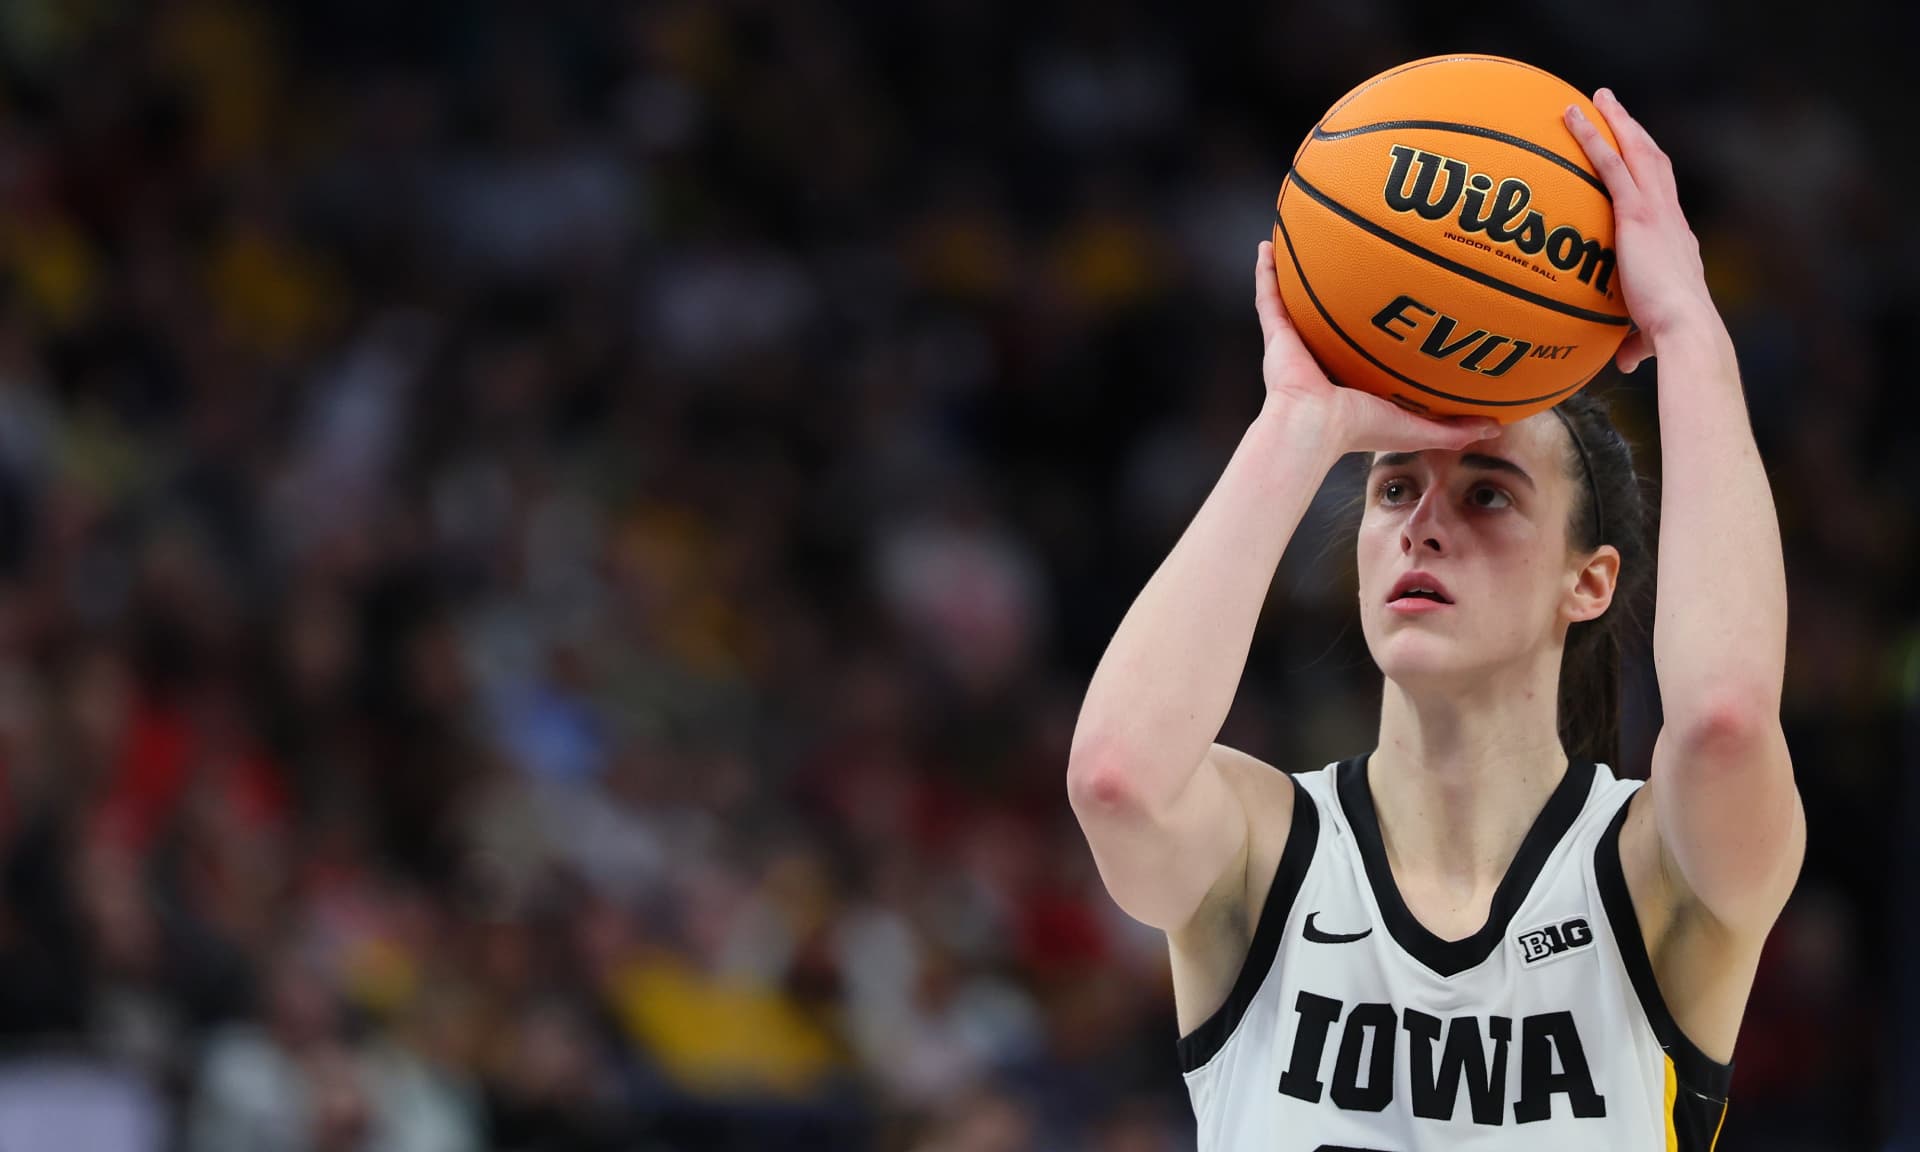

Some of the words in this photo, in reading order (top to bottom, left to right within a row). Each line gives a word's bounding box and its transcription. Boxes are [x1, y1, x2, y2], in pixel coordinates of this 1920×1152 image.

[1384, 144, 1615, 296] Wilson
[1443, 231, 1492, 253] INDOOR
[1495, 249, 1529, 268] GAME
[1531, 265, 1558, 282] BALL
[1371, 295, 1533, 377] EVO
[1529, 345, 1578, 360] NXT
[1278, 990, 1606, 1126] IOWA
